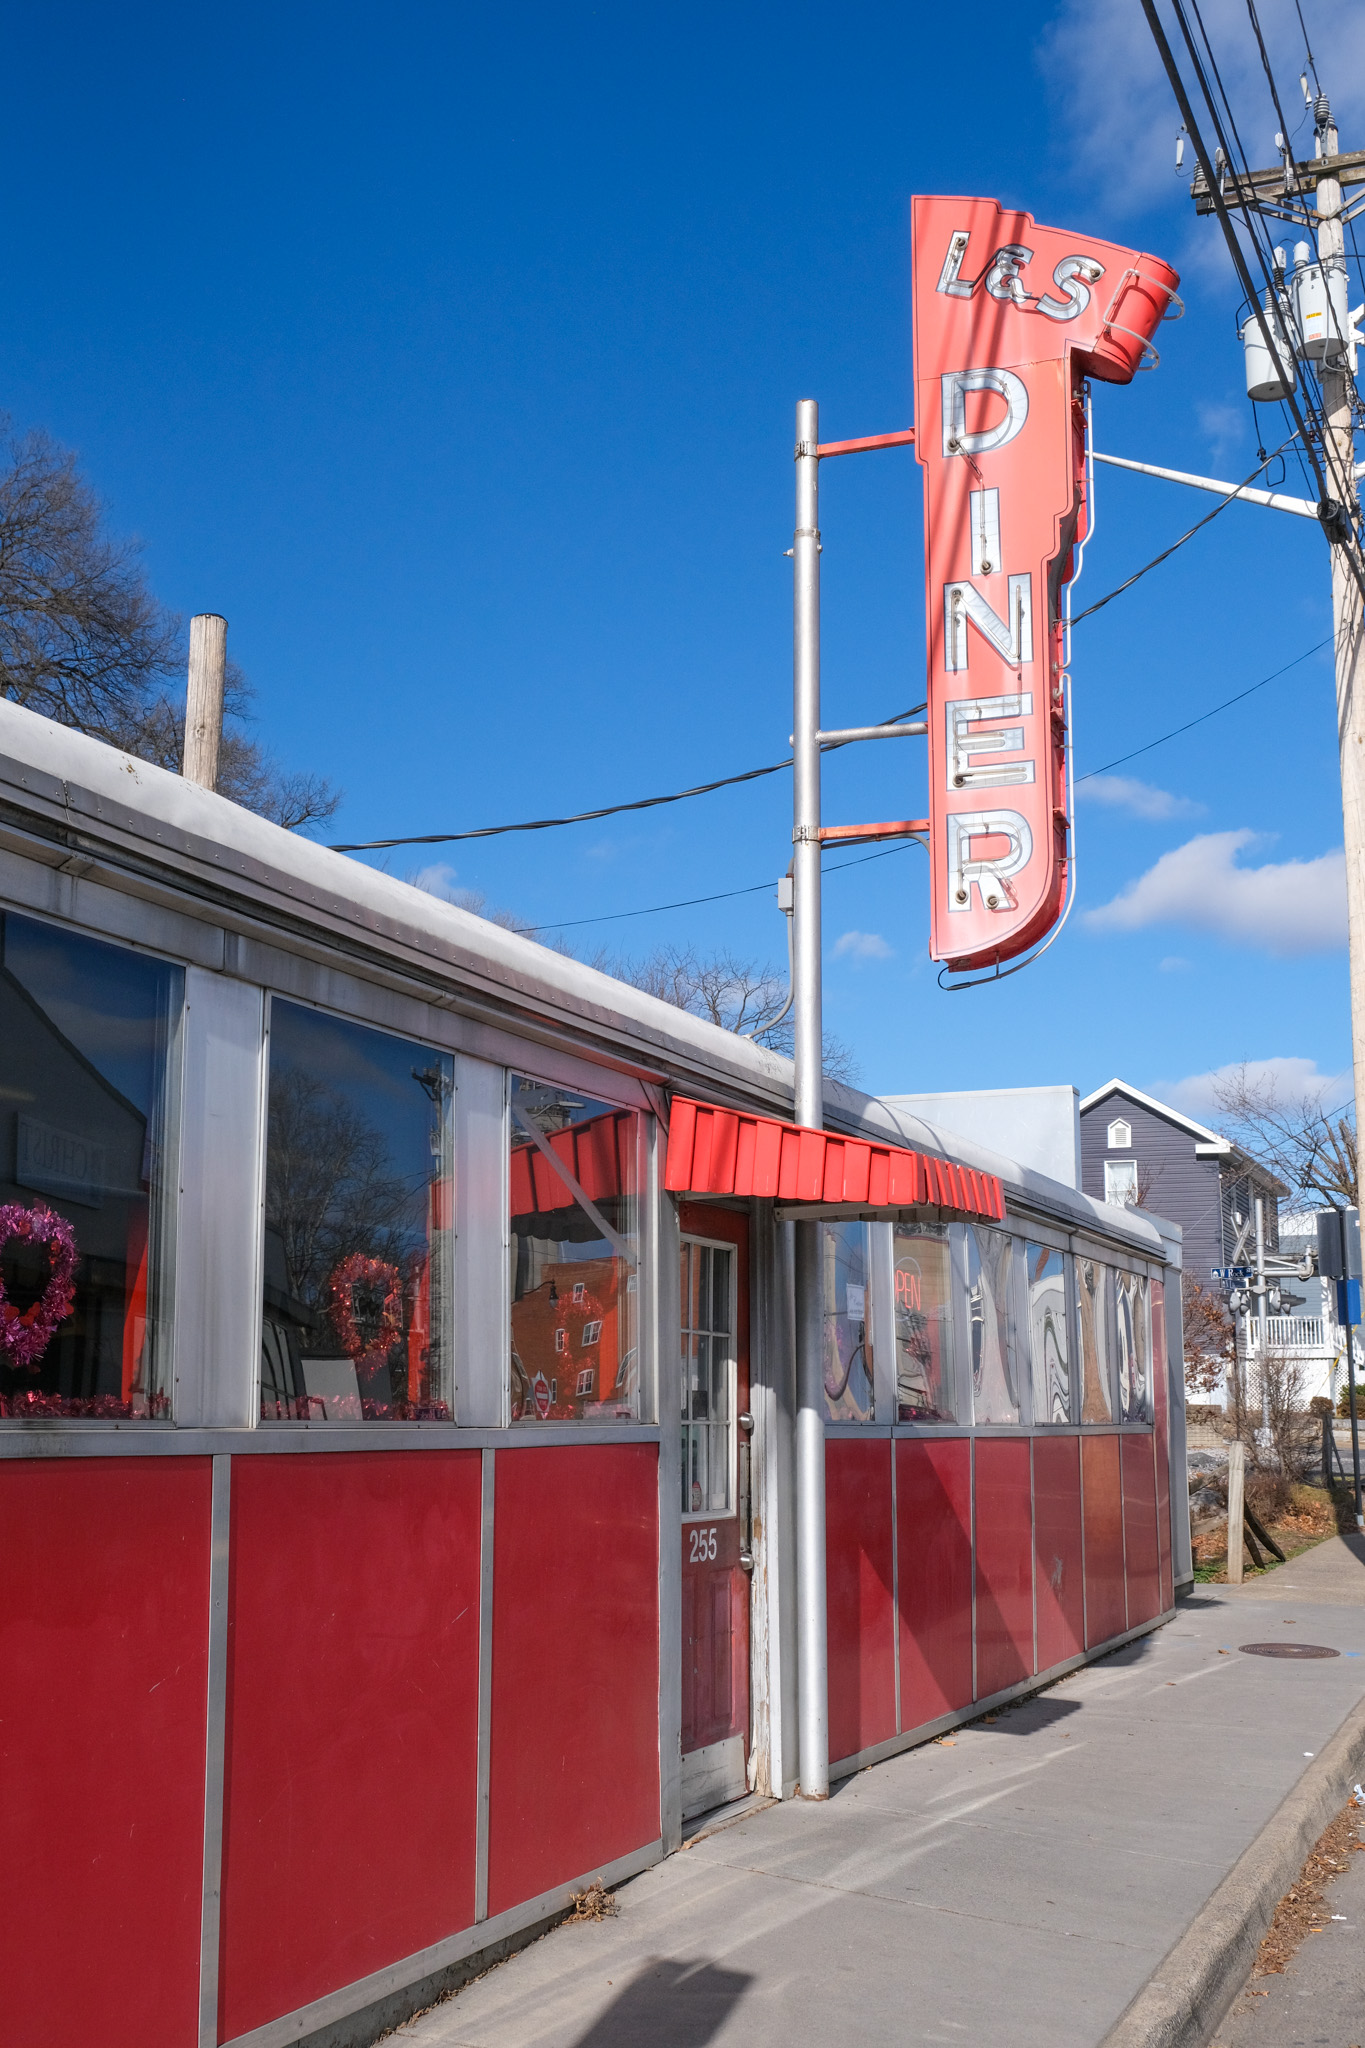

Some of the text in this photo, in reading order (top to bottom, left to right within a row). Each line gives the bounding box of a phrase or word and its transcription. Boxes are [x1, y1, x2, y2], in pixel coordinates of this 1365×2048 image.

[936, 230, 1106, 321] L&S
[941, 367, 1035, 913] DINER
[894, 1270, 921, 1311] PEN
[1220, 1269, 1225, 1278] W
[1228, 1268, 1244, 1278] Rock
[690, 1528, 717, 1563] 255
